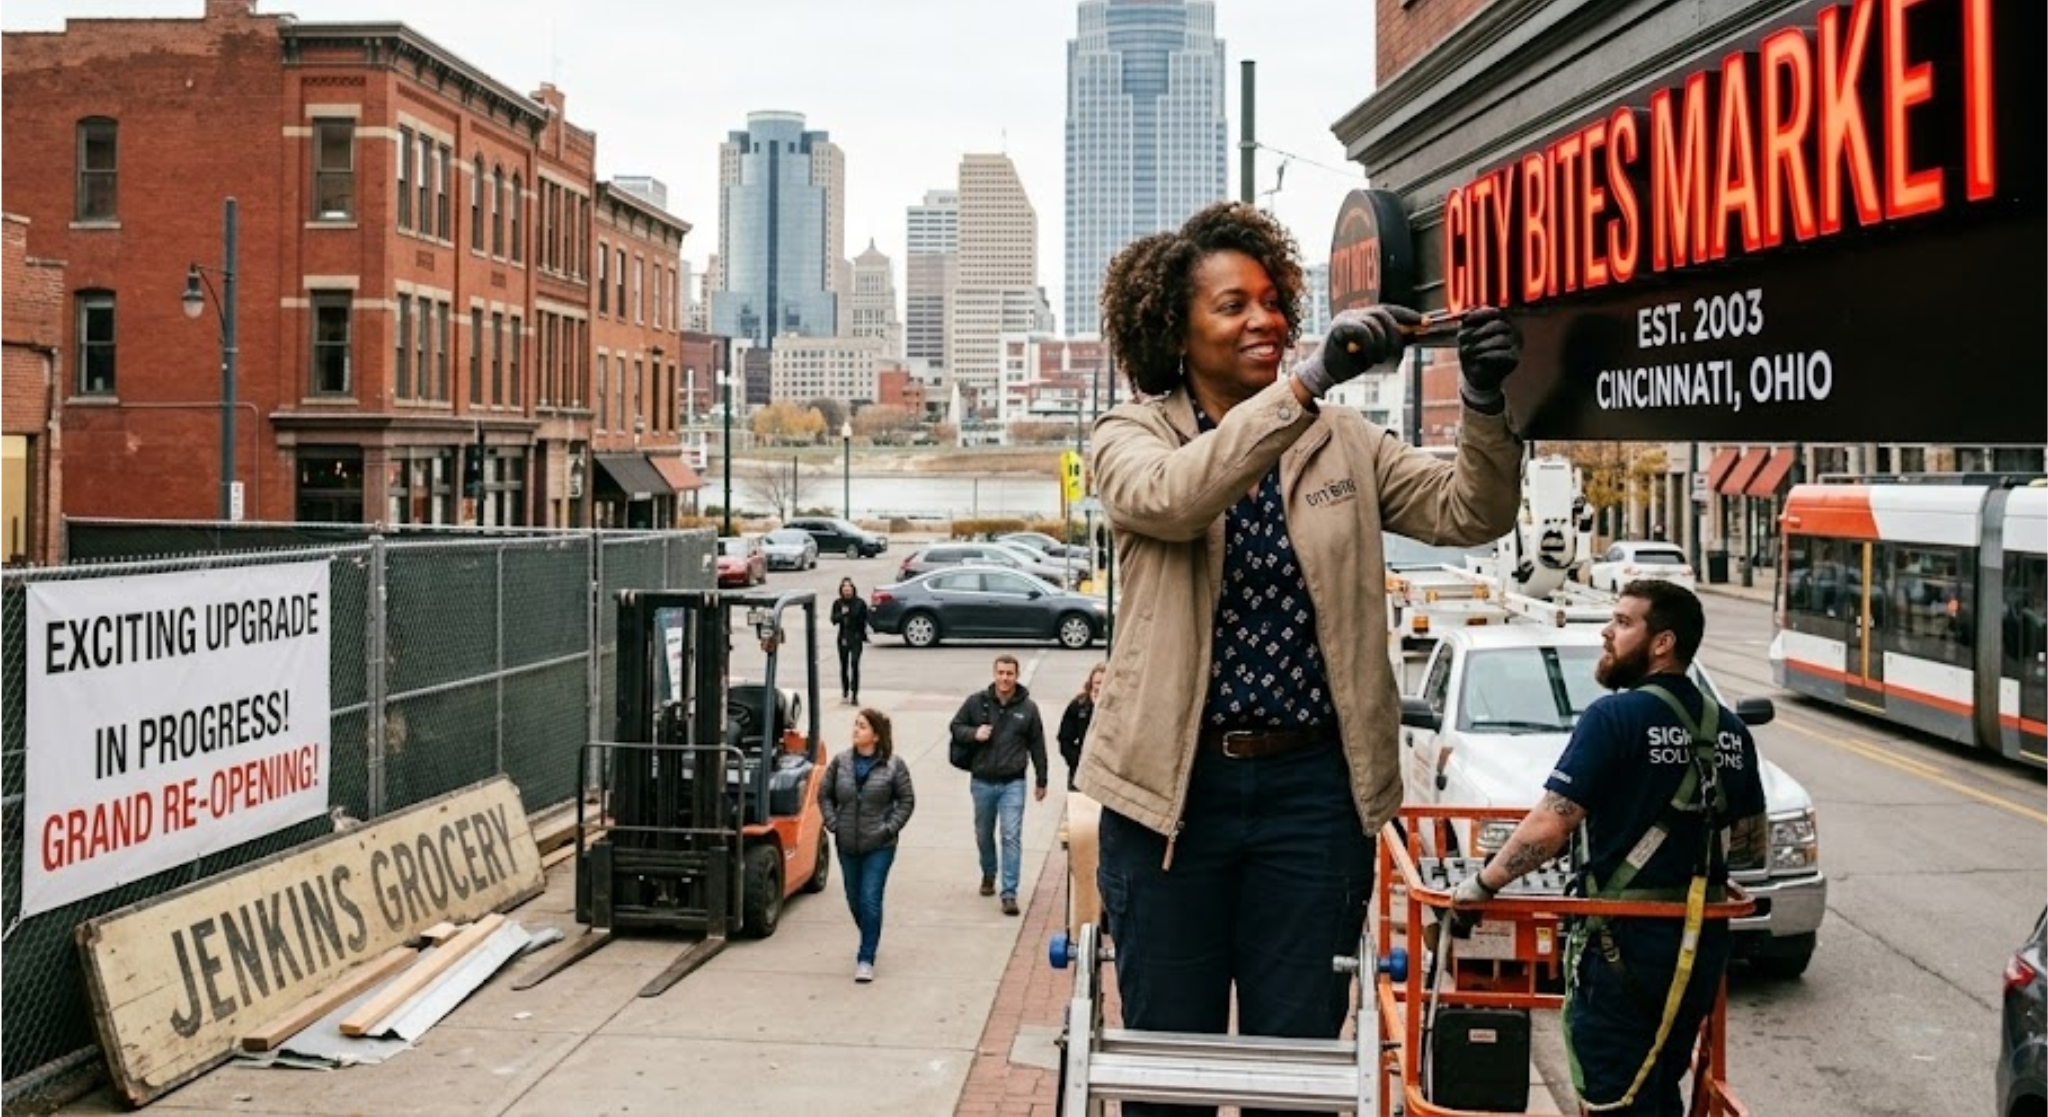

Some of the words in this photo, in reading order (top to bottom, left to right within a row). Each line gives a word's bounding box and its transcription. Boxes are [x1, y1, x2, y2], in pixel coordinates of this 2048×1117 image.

[1443, 162, 1523, 316] CITY
[1522, 106, 1640, 303] BITES
[1638, 305, 1687, 349] EST.
[1693, 288, 1763, 342] 2003
[1596, 358, 1742, 412] CINCINNATI,
[1750, 350, 1833, 403] OHIO
[46, 605, 197, 675] EXCITING
[206, 592, 319, 651] UPGRADE
[96, 723, 127, 780] IN
[139, 689, 290, 770] PROGRESS!
[1647, 725, 1743, 753] SIGNCH
[1649, 747, 1744, 771] SOLONS
[42, 791, 152, 872] GRAND
[162, 743, 320, 834] RE-OPENING!
[170, 864, 367, 1039] JENKINS
[370, 803, 519, 932] GROCERY
